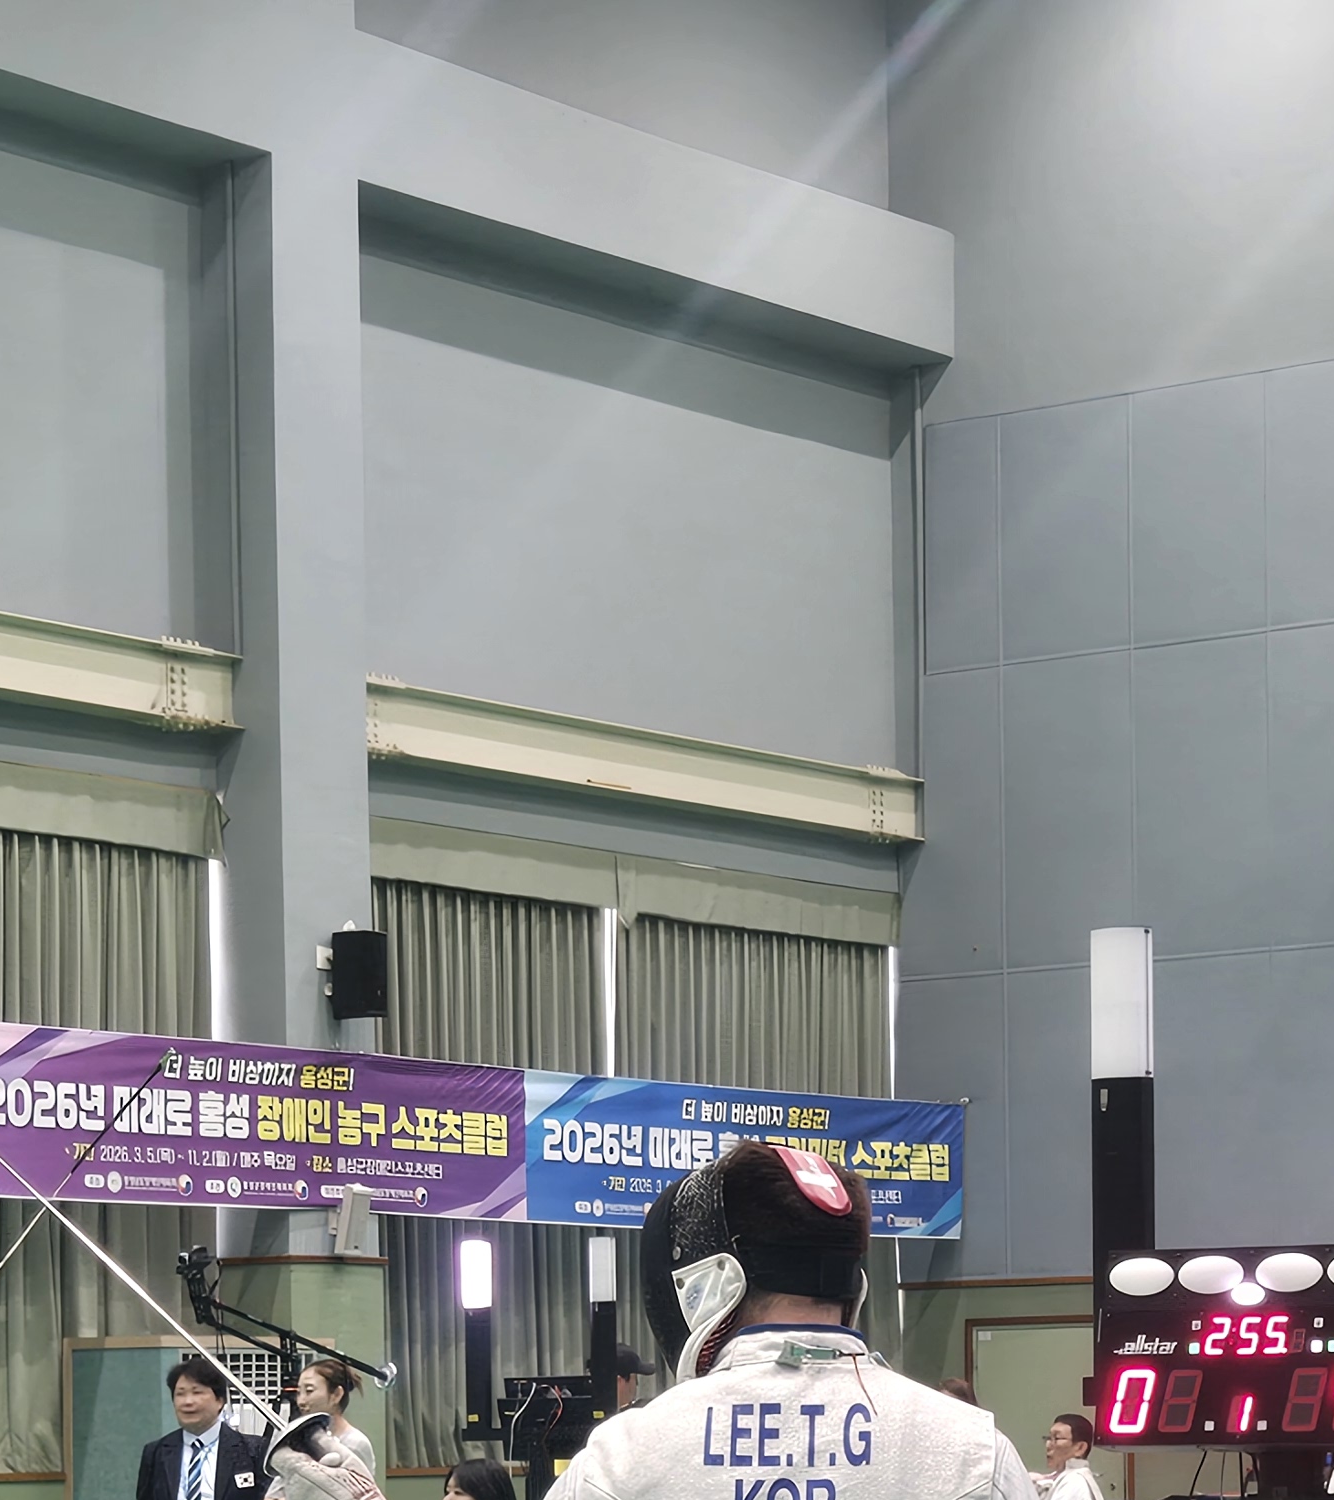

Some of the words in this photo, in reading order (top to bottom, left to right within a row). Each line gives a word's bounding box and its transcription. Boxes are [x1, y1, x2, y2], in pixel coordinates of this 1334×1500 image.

[187, 1056, 223, 1082] 높이
[112, 1086, 193, 1137] 미래로
[198, 1091, 250, 1140] 홍성
[257, 1095, 332, 1145] 장애인
[337, 1100, 386, 1147] 농구
[391, 1105, 508, 1157] 스포츠클럽
[542, 1118, 643, 1167] 2026년
[648, 1126, 715, 1171] 미래로
[850, 1141, 951, 1182] 스포츠클럽
[1116, 1334, 1178, 1355] allstar
[1108, 1368, 1157, 1435] 0
[703, 1402, 873, 1468] LEE.T.G
